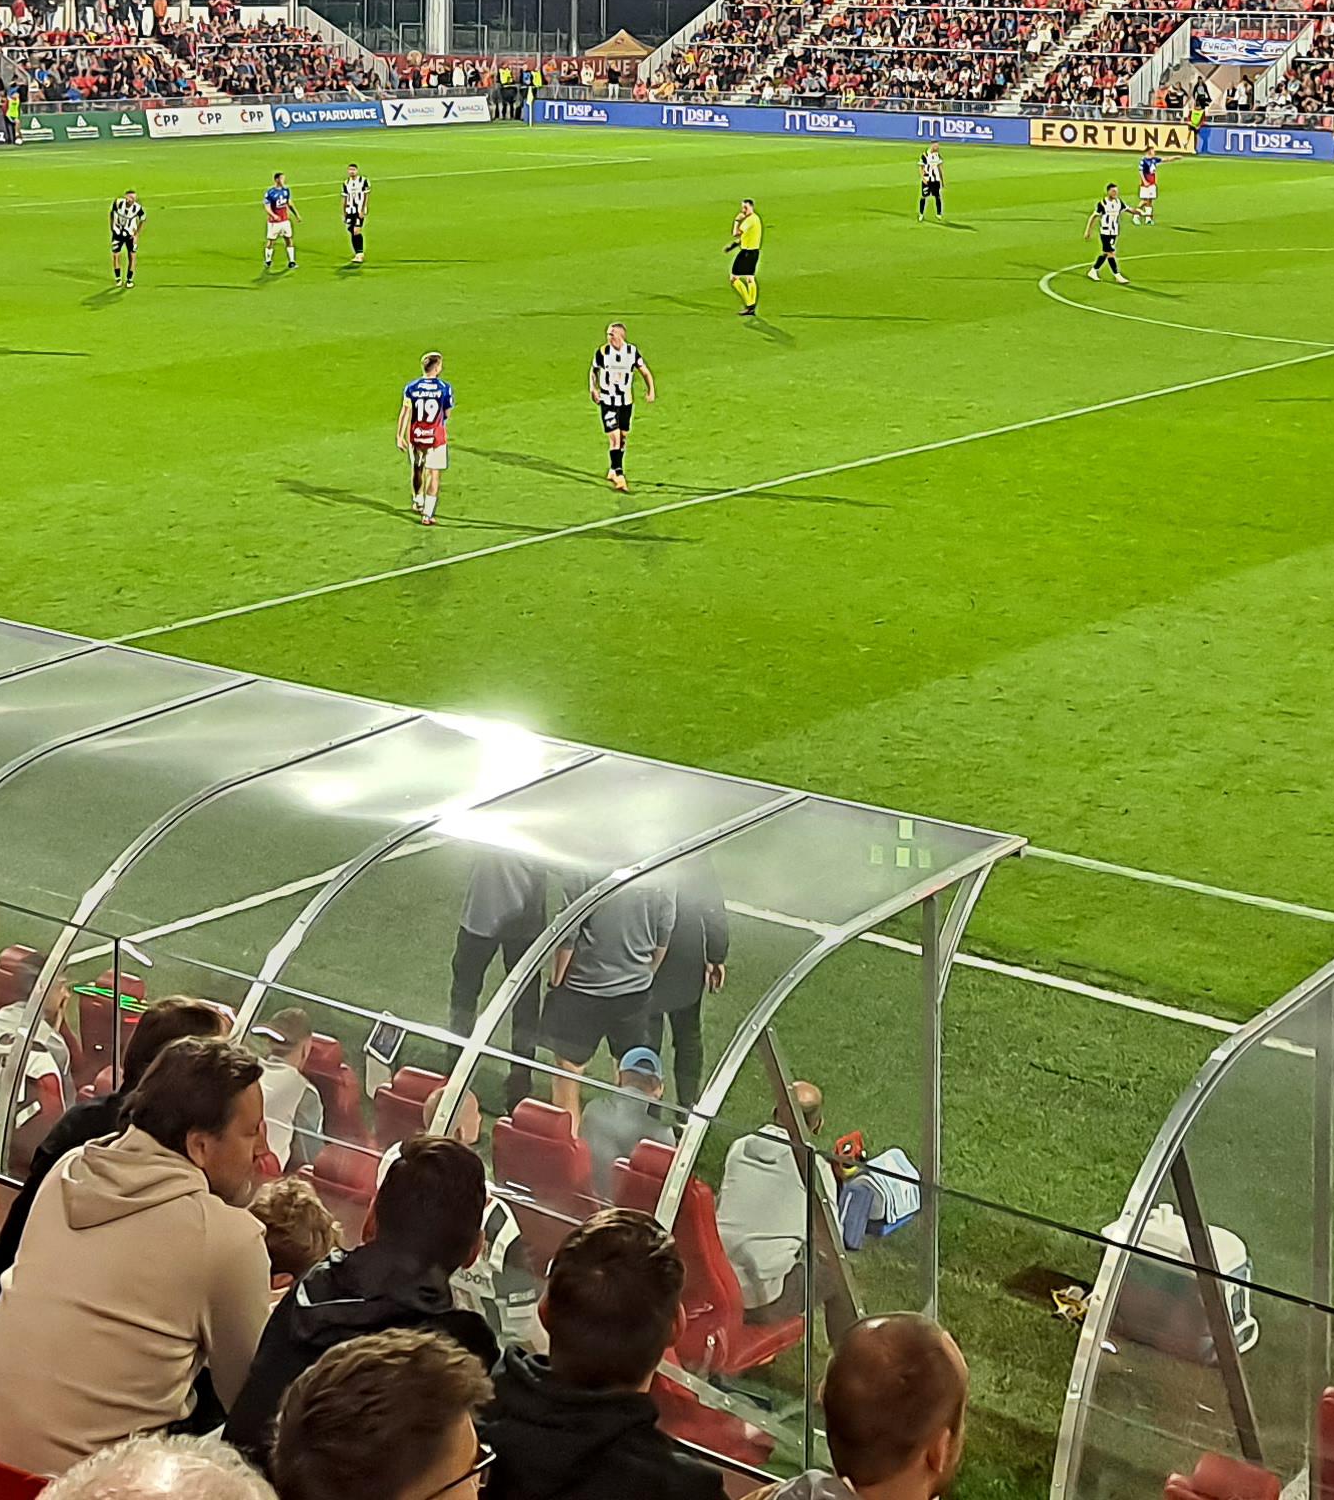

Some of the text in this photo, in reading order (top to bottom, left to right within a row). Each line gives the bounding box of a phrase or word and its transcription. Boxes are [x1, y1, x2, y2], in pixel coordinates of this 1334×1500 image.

[198, 110, 222, 125] ČPP
[240, 109, 264, 124] ČPP
[319, 108, 377, 121] PARDUBICE
[568, 104, 592, 117] DSP
[687, 109, 713, 122] DSP
[154, 112, 179, 127] ČPP
[810, 113, 838, 127] DSP
[946, 120, 975, 135] DSP
[1042, 122, 1181, 149] FORTUNA
[1257, 133, 1291, 148] DSP
[415, 399, 439, 422] 19
